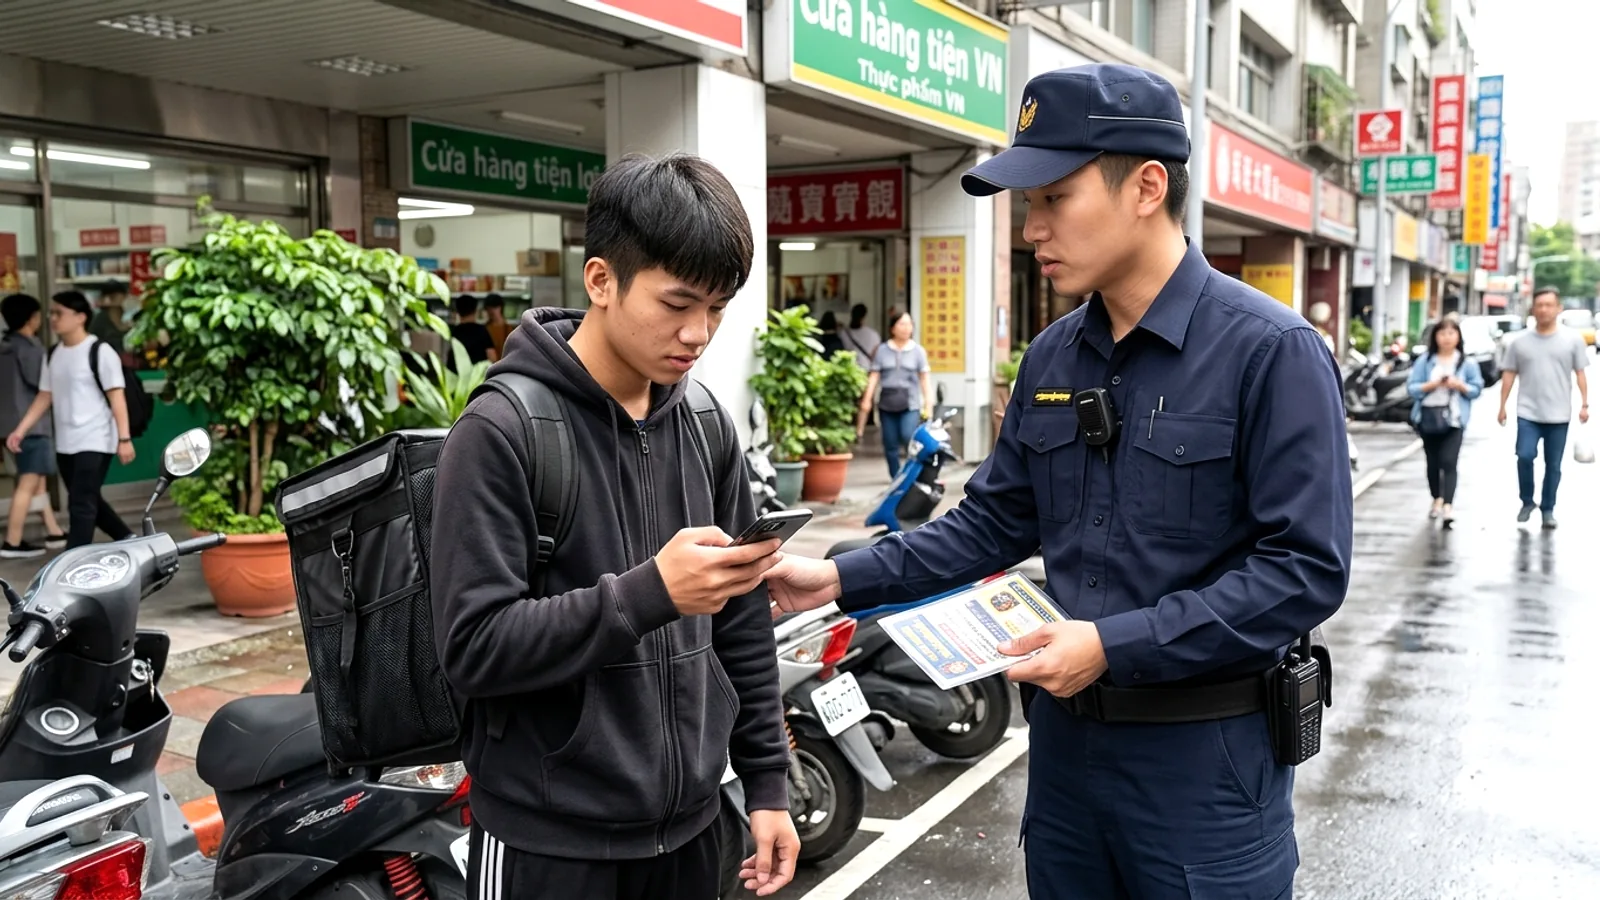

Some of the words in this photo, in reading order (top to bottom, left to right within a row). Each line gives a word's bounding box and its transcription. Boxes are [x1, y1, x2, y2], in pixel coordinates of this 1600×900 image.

[860, 0, 920, 73] hàng
[926, 28, 969, 86] tiện
[973, 47, 1003, 95] VN
[944, 89, 966, 115] VN
[421, 139, 467, 175] Cửa
[474, 146, 528, 190] hàng
[534, 156, 572, 193] tiện
